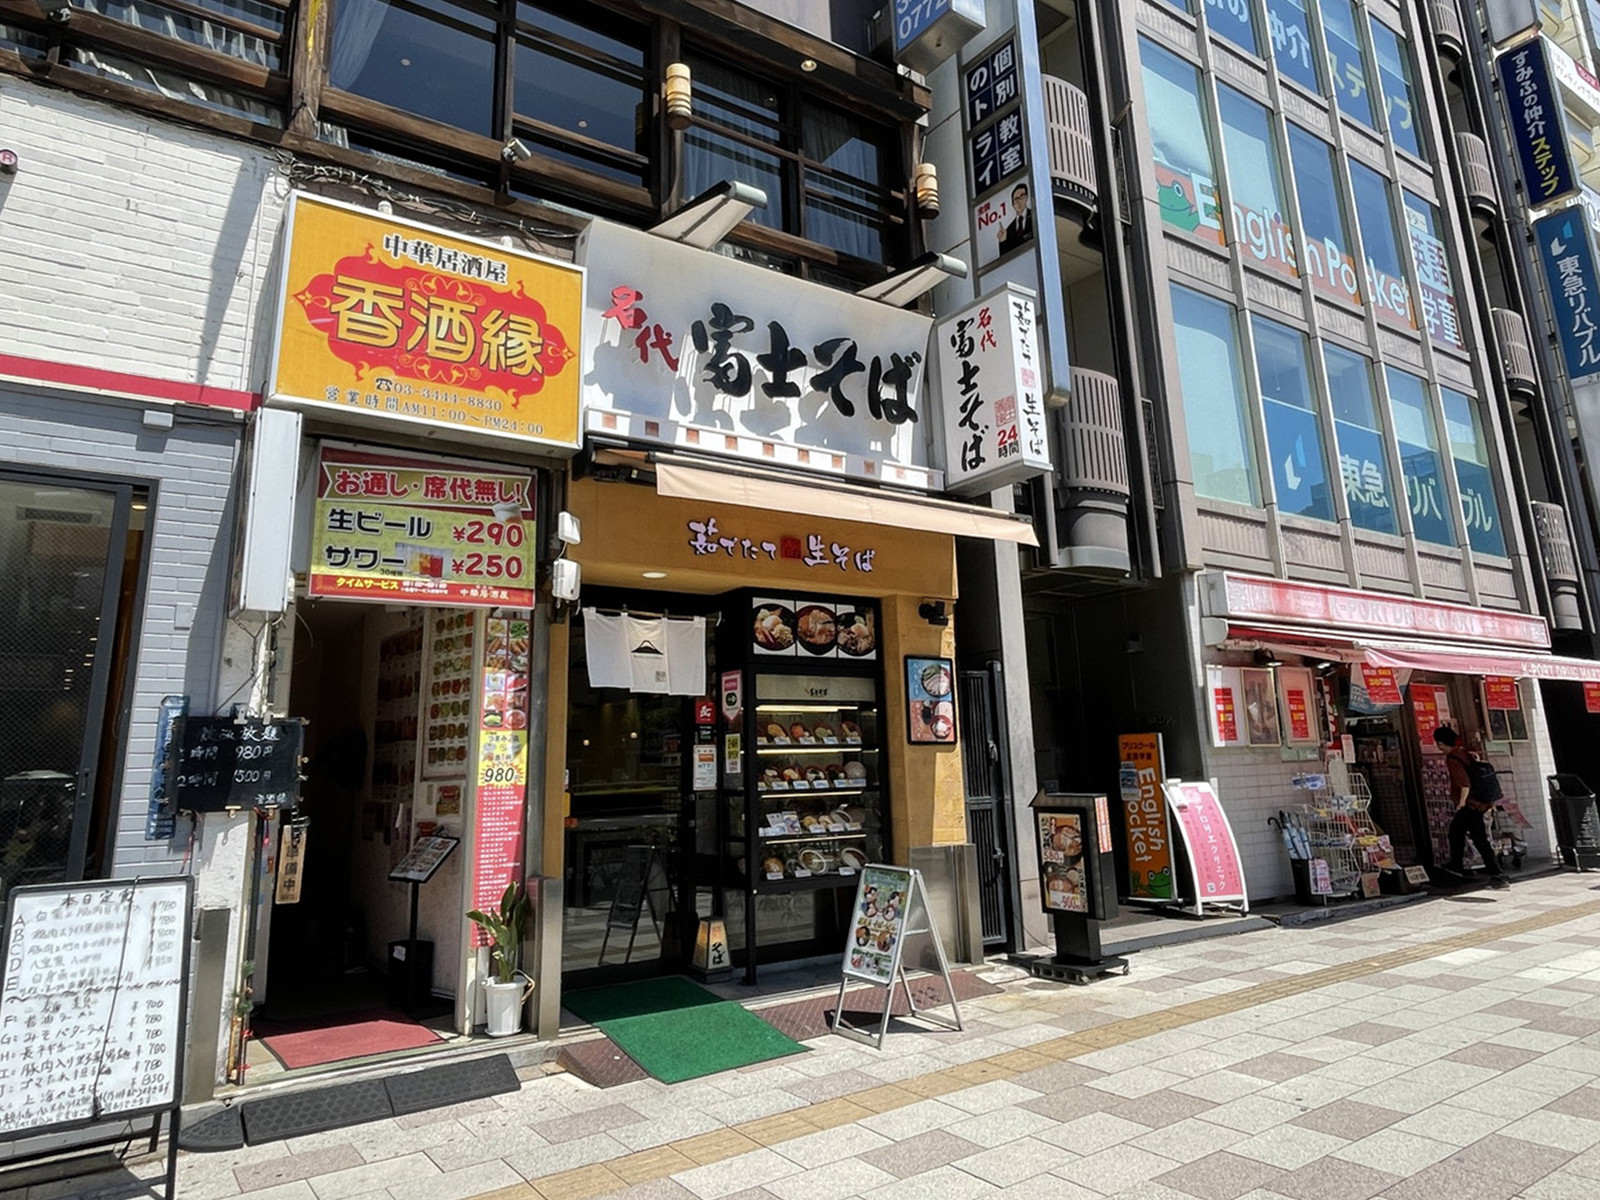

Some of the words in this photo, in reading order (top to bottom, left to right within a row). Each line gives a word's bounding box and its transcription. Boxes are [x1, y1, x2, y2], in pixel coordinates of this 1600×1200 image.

[970, 69, 991, 187] のトライ
[993, 45, 1022, 174] 個別教室
[1512, 51, 1558, 197] すみふの仲介ステップ
[978, 202, 1006, 230] No.1
[384, 236, 507, 284] 中華居酒屋
[330, 274, 544, 377] 香酒縁
[976, 307, 997, 352] 名代
[1556, 254, 1600, 367] 東急リバブル
[602, 286, 680, 373] 名代
[691, 302, 922, 425] 富士そば
[393, 383, 502, 411] 03-3444-8830
[950, 317, 989, 472] 富士そば
[997, 425, 1018, 446] 24
[328, 508, 432, 539] 生ビール
[452, 520, 523, 547] ¥290
[325, 545, 405, 569] サワー
[688, 517, 777, 560] 茹でたて
[803, 534, 875, 572] 生そば
[451, 552, 523, 579] ¥250
[1127, 789, 1153, 862] ocket
[1138, 767, 1165, 851] English
[12, 929, 25, 943] B
[13, 915, 26, 928] A
[9, 958, 22, 972] D
[712, 942, 727, 965] そば
[5, 976, 20, 992] E
